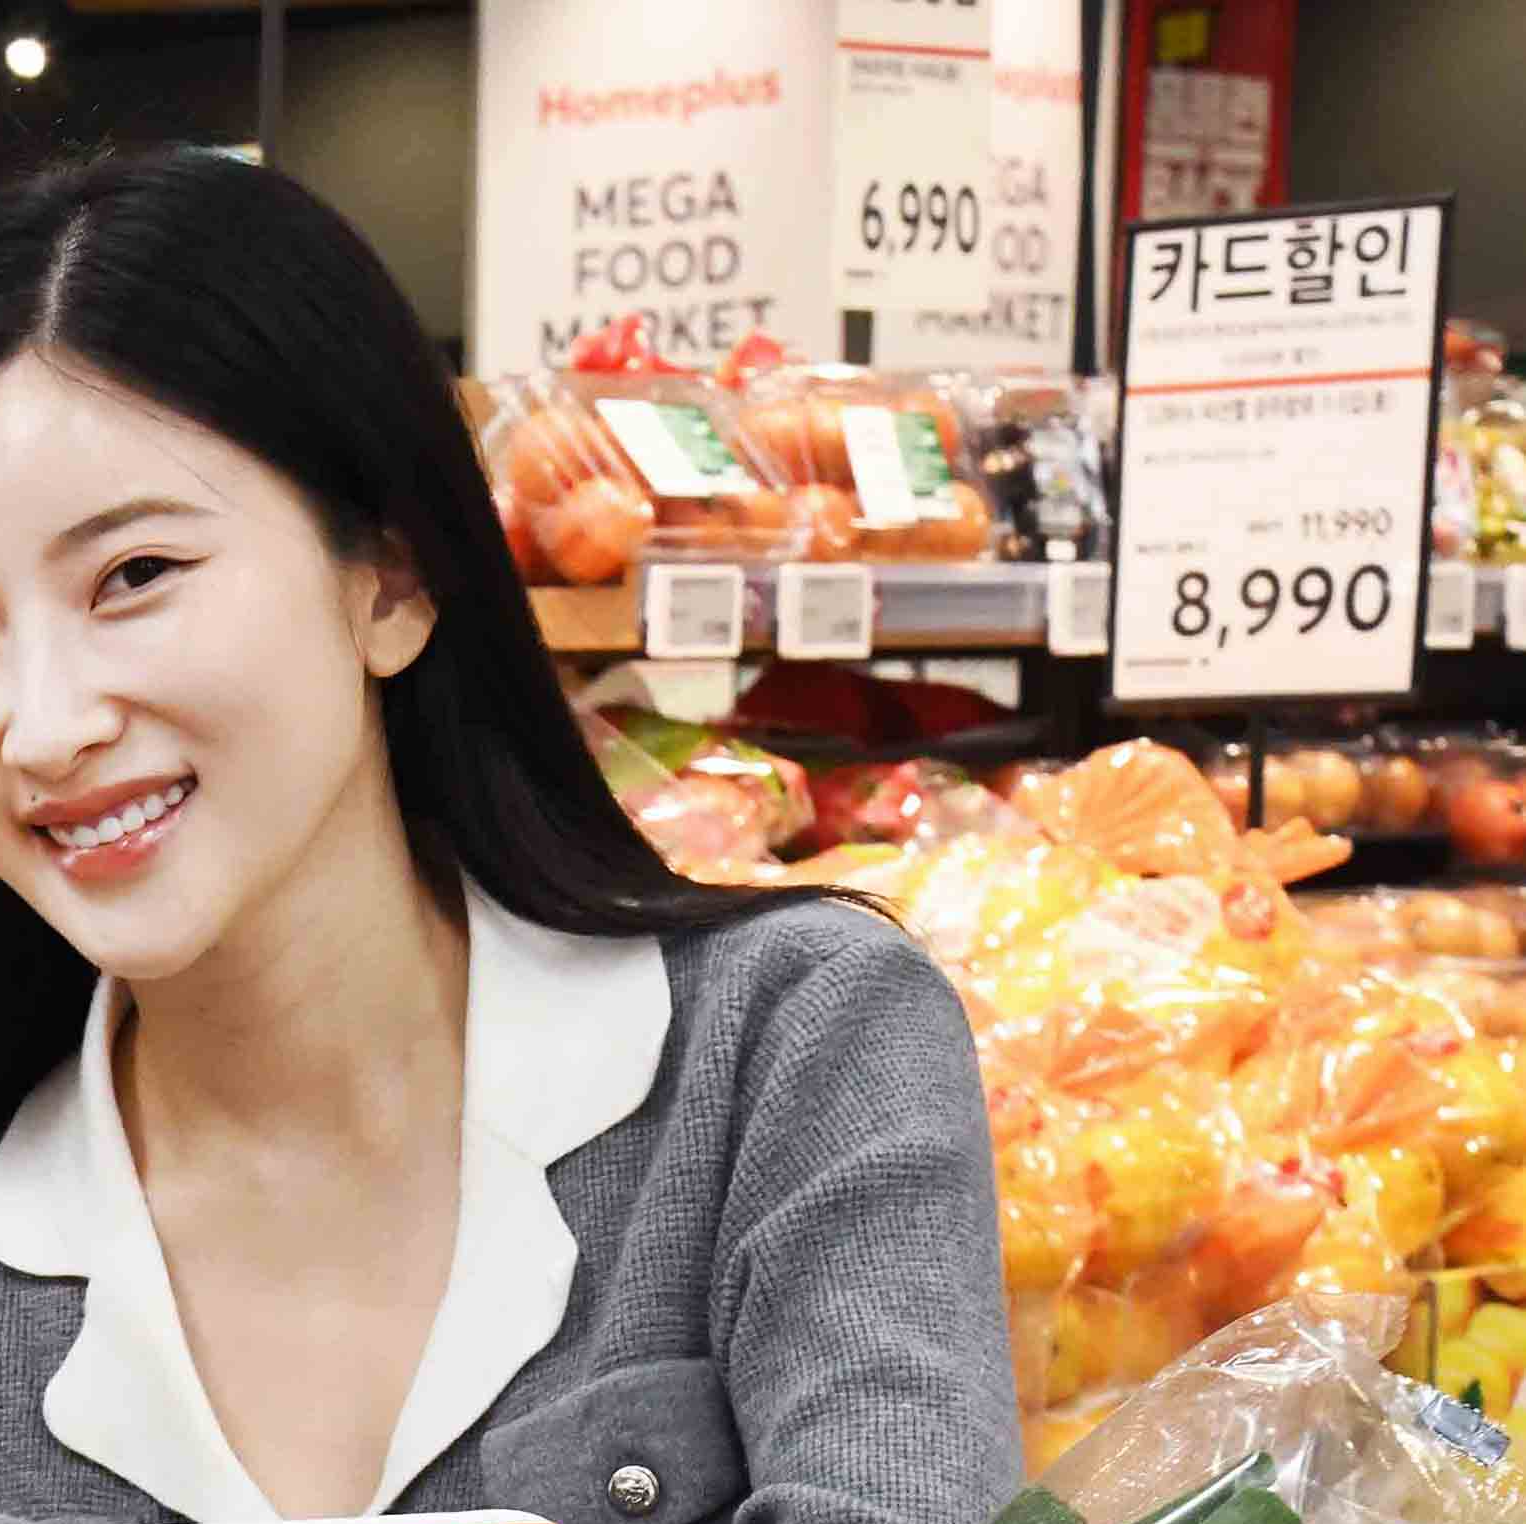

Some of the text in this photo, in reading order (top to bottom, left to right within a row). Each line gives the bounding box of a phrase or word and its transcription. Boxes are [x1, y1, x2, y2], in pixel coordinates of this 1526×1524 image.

[539, 70, 780, 127] Homeplus
[575, 172, 739, 231] MEGA
[988, 156, 1048, 211] GA
[861, 181, 981, 258] 6,990
[575, 236, 741, 295] FOOD
[1149, 210, 1412, 312] 카드할인
[1300, 509, 1394, 542] 11,990
[1171, 564, 1392, 650] 8,990
